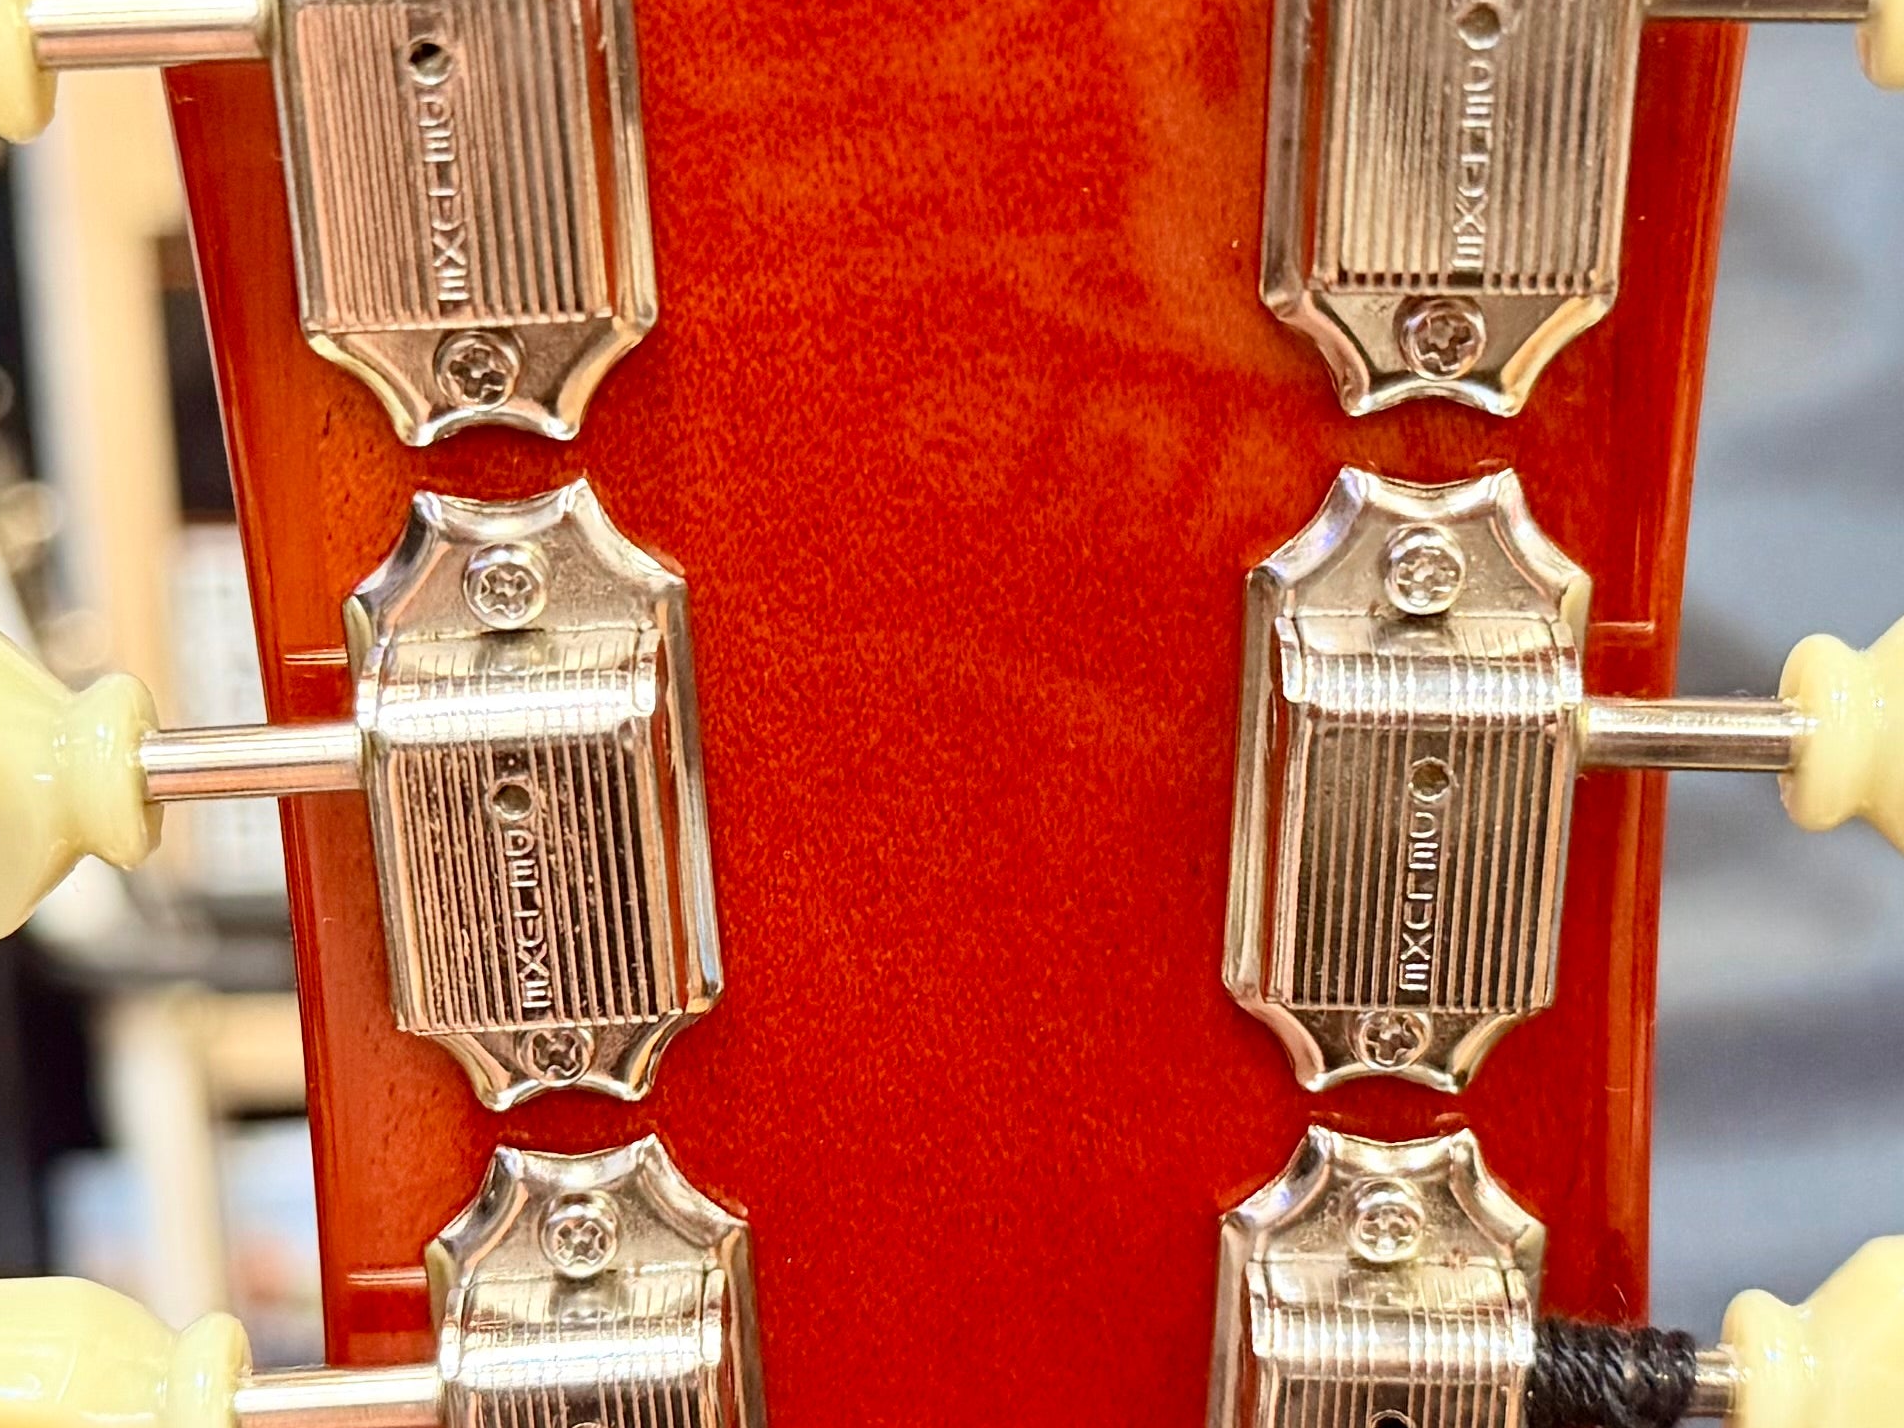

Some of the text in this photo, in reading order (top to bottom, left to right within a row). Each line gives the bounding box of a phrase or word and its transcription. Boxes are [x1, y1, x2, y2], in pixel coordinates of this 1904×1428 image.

[418, 93, 470, 306] DELUXE
[1453, 58, 1495, 270] DELUXE
[506, 828, 555, 1011] DELUXE
[1402, 811, 1440, 993] DELUXE
